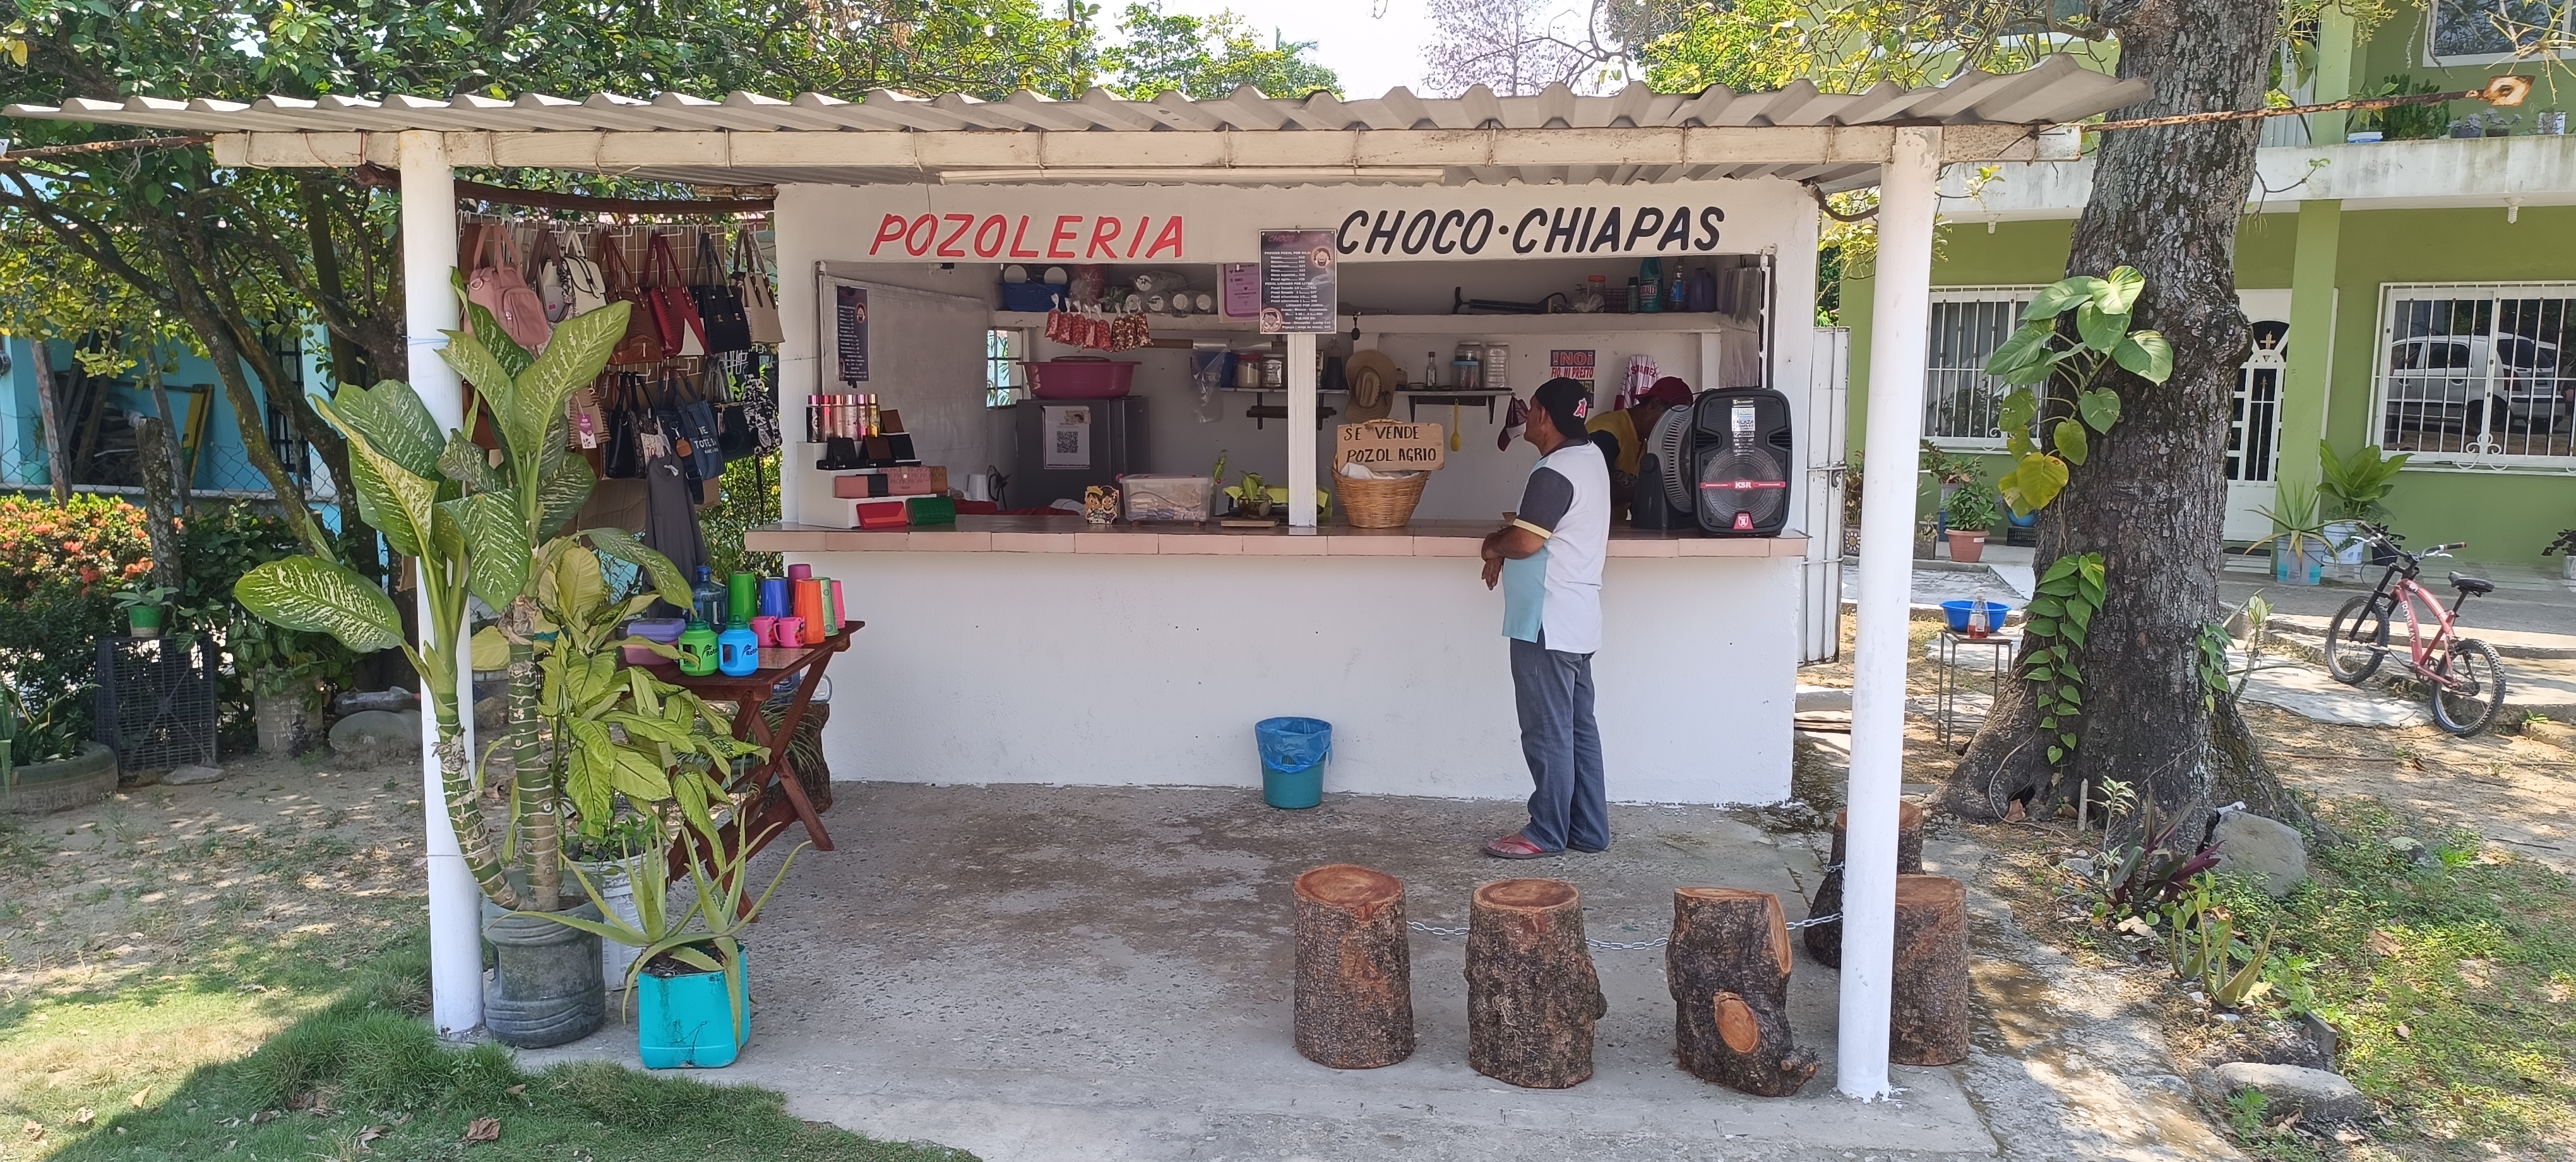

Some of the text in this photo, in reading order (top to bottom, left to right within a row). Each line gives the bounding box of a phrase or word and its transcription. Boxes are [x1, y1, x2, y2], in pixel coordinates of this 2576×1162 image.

[869, 213, 1182, 260] POZOLERIA
[1512, 206, 1725, 253] CHIAPAS
[1564, 367, 1571, 378] NI
[1572, 367, 1594, 378] PRESTO
[1344, 426, 1420, 441] SE VENDE
[1346, 448, 1436, 463] POZOL AGRIO
